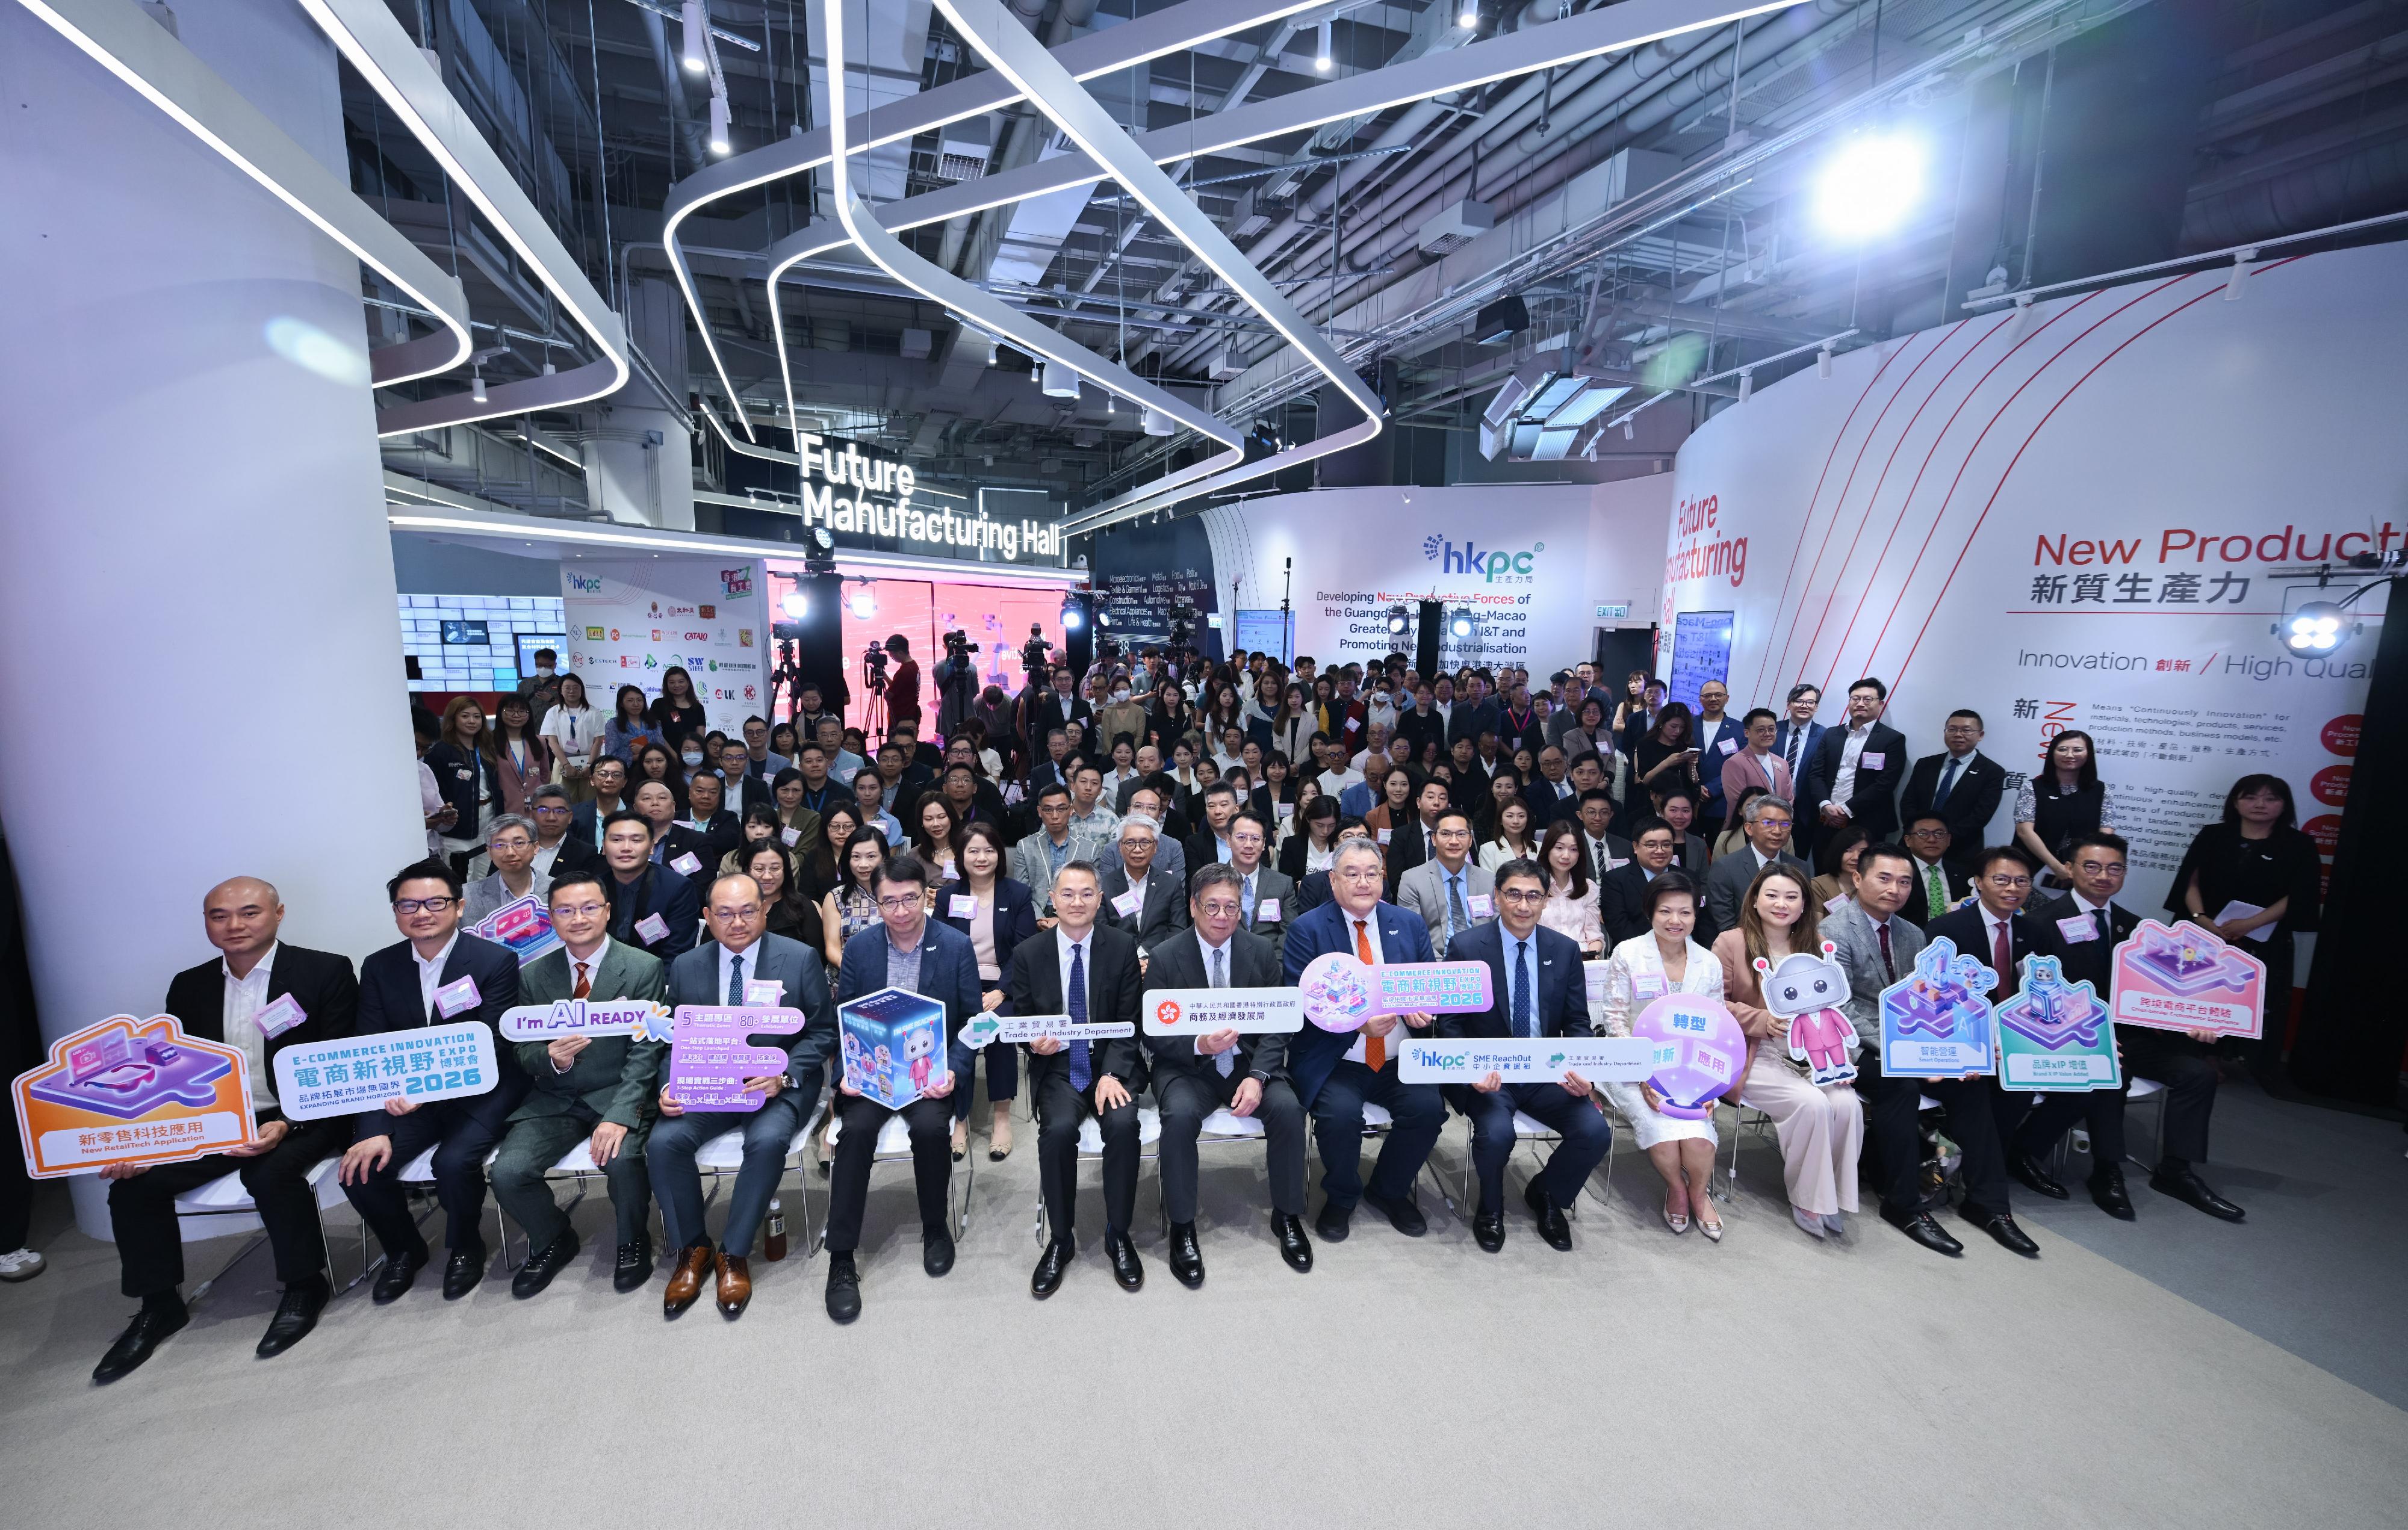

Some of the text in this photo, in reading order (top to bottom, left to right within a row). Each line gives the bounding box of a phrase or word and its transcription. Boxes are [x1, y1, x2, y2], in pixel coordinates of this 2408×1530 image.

[799, 432, 914, 496] Future
[802, 483, 1060, 560] Manufacturing Hall
[1678, 494, 1718, 540] Future
[2034, 522, 2408, 566] New Product
[1443, 542, 1534, 583] hkpc
[1665, 537, 1748, 587] anufacturing
[573, 575, 601, 593] hkpc
[2031, 572, 2251, 604] 新質生產力
[1144, 595, 1166, 604] Automotive
[1317, 591, 1531, 604] Developing Forces of
[1127, 607, 1147, 618] Appliances
[1325, 607, 1342, 617] the
[1597, 607, 1625, 617] EXIT 出口
[684, 632, 708, 641] CATALO
[1481, 627, 1525, 637] I&T and
[1340, 639, 1527, 654] Promoting dustrialisation
[2019, 649, 2147, 671] Innovation
[2155, 658, 2192, 672] 創新
[2225, 655, 2292, 681] High
[2013, 698, 2039, 719] 新
[2179, 730, 2221, 739] business
[2144, 786, 2199, 798] high-quality
[2114, 794, 2224, 810] ntinuous enhancemen
[2148, 818, 2182, 826] tandem
[2164, 810, 2205, 819] products
[2145, 827, 2186, 838] industries
[1381, 969, 1431, 977] E-COMMERCE
[1381, 977, 1457, 994] 電商新視野
[1460, 983, 1482, 991] 博覽會
[1190, 1001, 1296, 1009] 中華人民共和國香港特別行政區政府
[1439, 993, 1483, 1006] 2026
[2140, 997, 2232, 1018] 跨境電商平台體驗
[547, 1002, 585, 1029] AI
[591, 1011, 645, 1025] READY
[681, 1011, 692, 1027] 5
[1190, 1011, 1265, 1021] 商務及經濟發展局
[1673, 1013, 1706, 1032] 轉型
[1005, 1020, 1068, 1030] 工業貿易署
[1085, 1027, 1132, 1035] Department
[1958, 1016, 1974, 1040] AI
[293, 1033, 475, 1065] E-COMMERCE INNOVATION
[439, 1045, 477, 1057] EXPO
[1920, 1046, 1957, 1056] 智能營運
[439, 1054, 479, 1069] 博覽會
[1422, 1051, 1465, 1070] hkpc
[1492, 1055, 1531, 1063] ReachOut
[1698, 1050, 1725, 1074] 應用
[2068, 1059, 2088, 1070] 增值
[294, 1051, 435, 1088] 電商新視野
[405, 1068, 482, 1095] 2026
[299, 1080, 400, 1103] 品牌拓展市場無國界
[300, 1091, 402, 1110] EXPANDING BRAND HORIZONS
[78, 1121, 203, 1147] 新零售科技應用
[104, 1141, 150, 1152] RetailTech
[154, 1135, 205, 1146] Application
